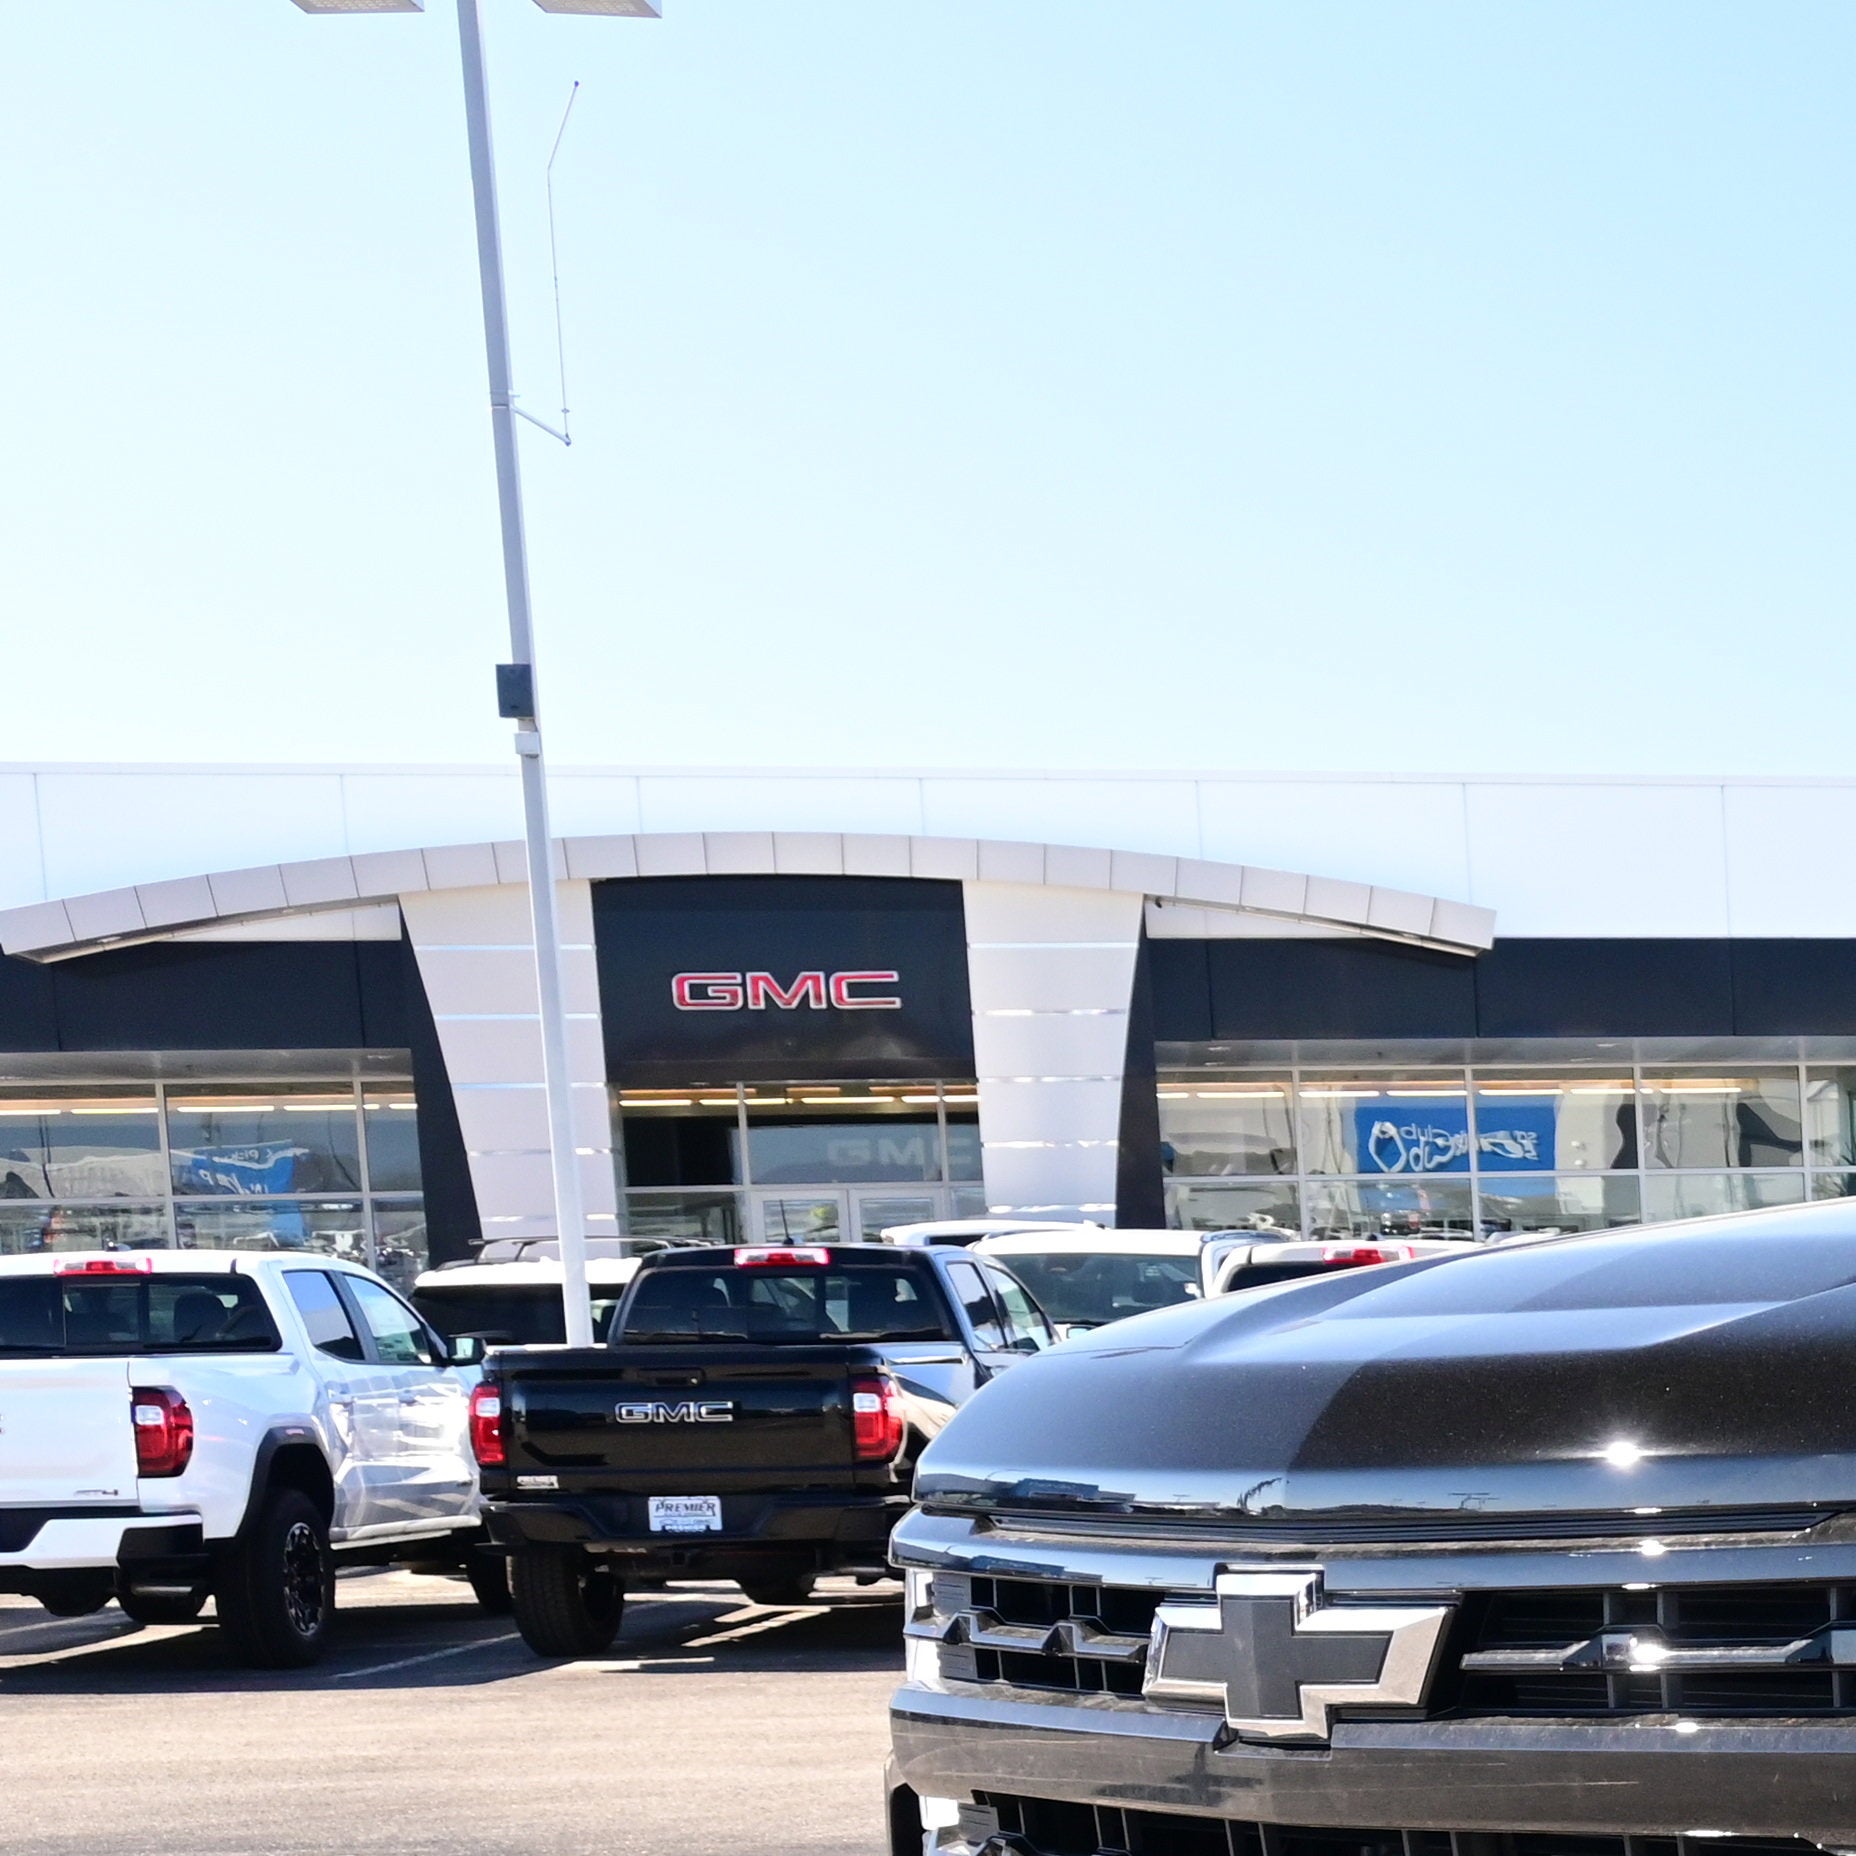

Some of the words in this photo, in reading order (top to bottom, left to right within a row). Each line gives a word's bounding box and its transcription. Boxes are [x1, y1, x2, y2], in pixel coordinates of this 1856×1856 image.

[671, 971, 902, 1010] GMC
[827, 1136, 973, 1166] GMC
[615, 1401, 733, 1423] GMC
[655, 1501, 716, 1517] PREMIER
